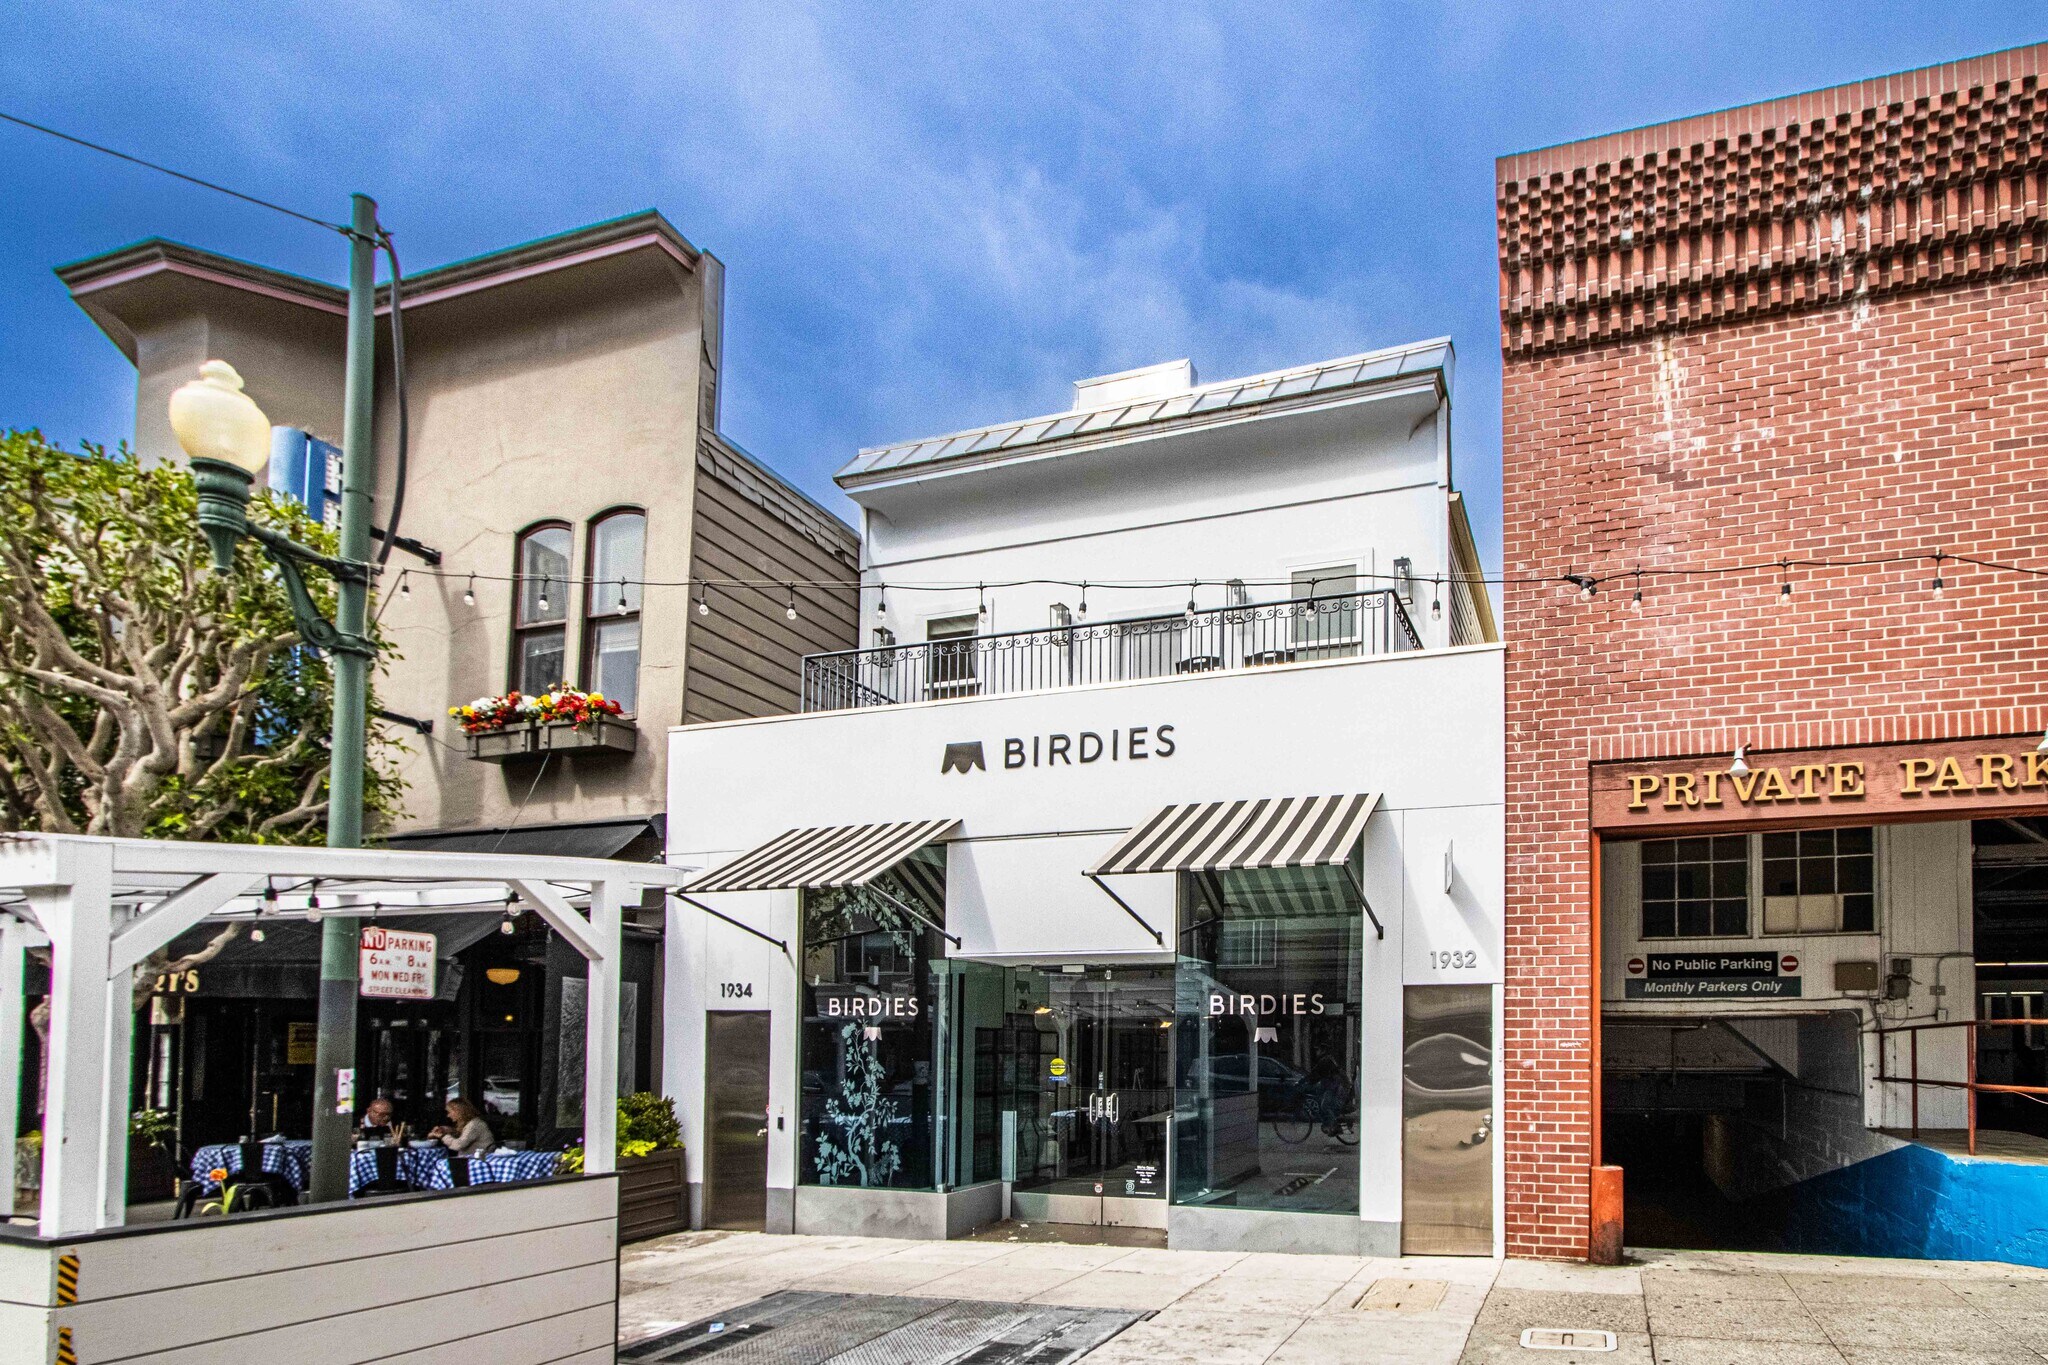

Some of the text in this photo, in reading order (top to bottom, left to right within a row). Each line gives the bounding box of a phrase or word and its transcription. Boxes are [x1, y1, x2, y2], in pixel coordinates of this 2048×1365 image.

[1004, 724, 1176, 769] BIRDIES
[1627, 761, 1866, 809] PRIVATE
[363, 930, 432, 953] NO PARKING
[369, 953, 378, 965] 6
[407, 955, 415, 967] 8
[1429, 950, 1477, 969] 1932
[1652, 958, 1773, 971] No Public Parking
[371, 970, 426, 984] MON WED FRI
[368, 985, 394, 995] STREET
[720, 982, 753, 998] 1934
[1644, 980, 1783, 994] Monthly Parkers Only
[828, 997, 919, 1017] BIRDIES
[1209, 993, 1325, 1016] BIRDIES
